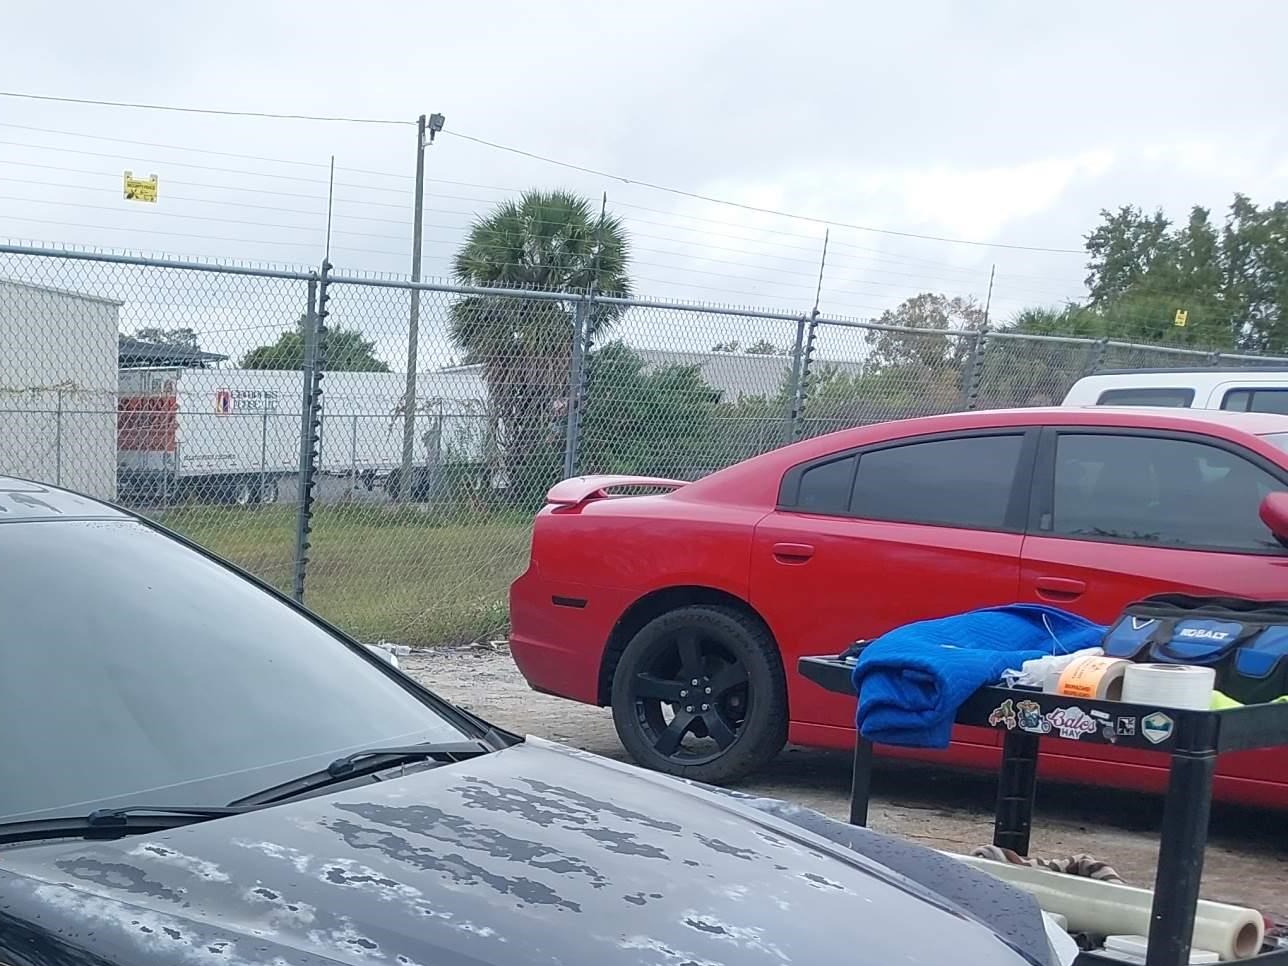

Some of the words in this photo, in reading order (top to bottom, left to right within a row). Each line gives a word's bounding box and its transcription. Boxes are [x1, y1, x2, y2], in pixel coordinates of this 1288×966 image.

[1179, 628, 1230, 640] KOBALT
[1047, 709, 1096, 732] Bales
[1061, 728, 1081, 738] HAY
